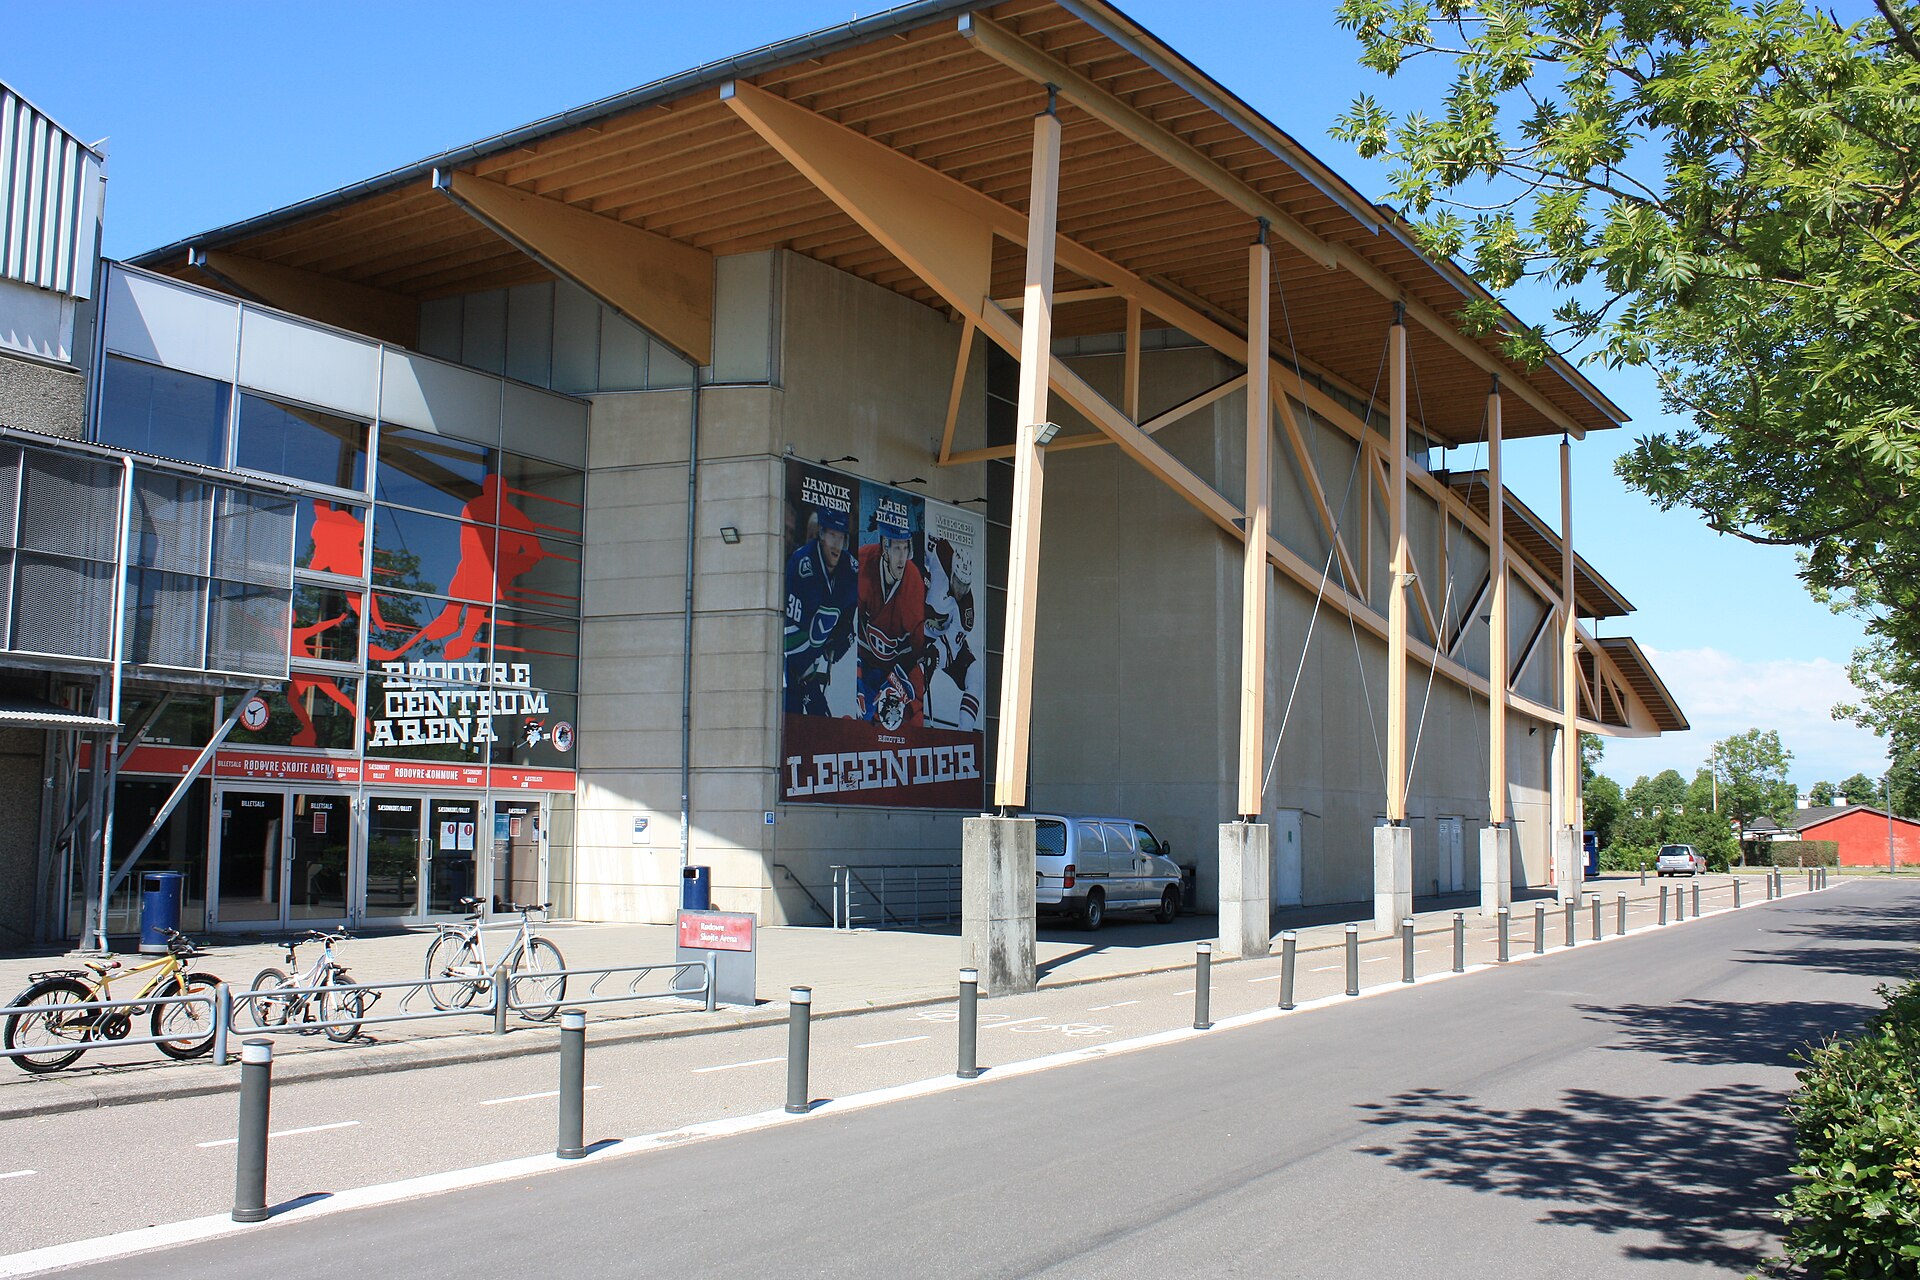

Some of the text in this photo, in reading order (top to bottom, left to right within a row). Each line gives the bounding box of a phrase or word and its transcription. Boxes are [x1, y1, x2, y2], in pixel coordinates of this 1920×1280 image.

[802, 476, 851, 500] JANNIK
[801, 489, 852, 513] HANSEN
[878, 498, 908, 516] LARS
[875, 510, 910, 529] ELLER
[786, 593, 802, 623] 36
[381, 659, 531, 691] RØDOVRE
[385, 690, 549, 718] CENTRUM
[369, 717, 499, 747] ARENA
[243, 760, 335, 775] RØDOVRE SKØJTE ARENA
[426, 769, 459, 780] KOMMUNE
[786, 744, 980, 797] LEGENDER
